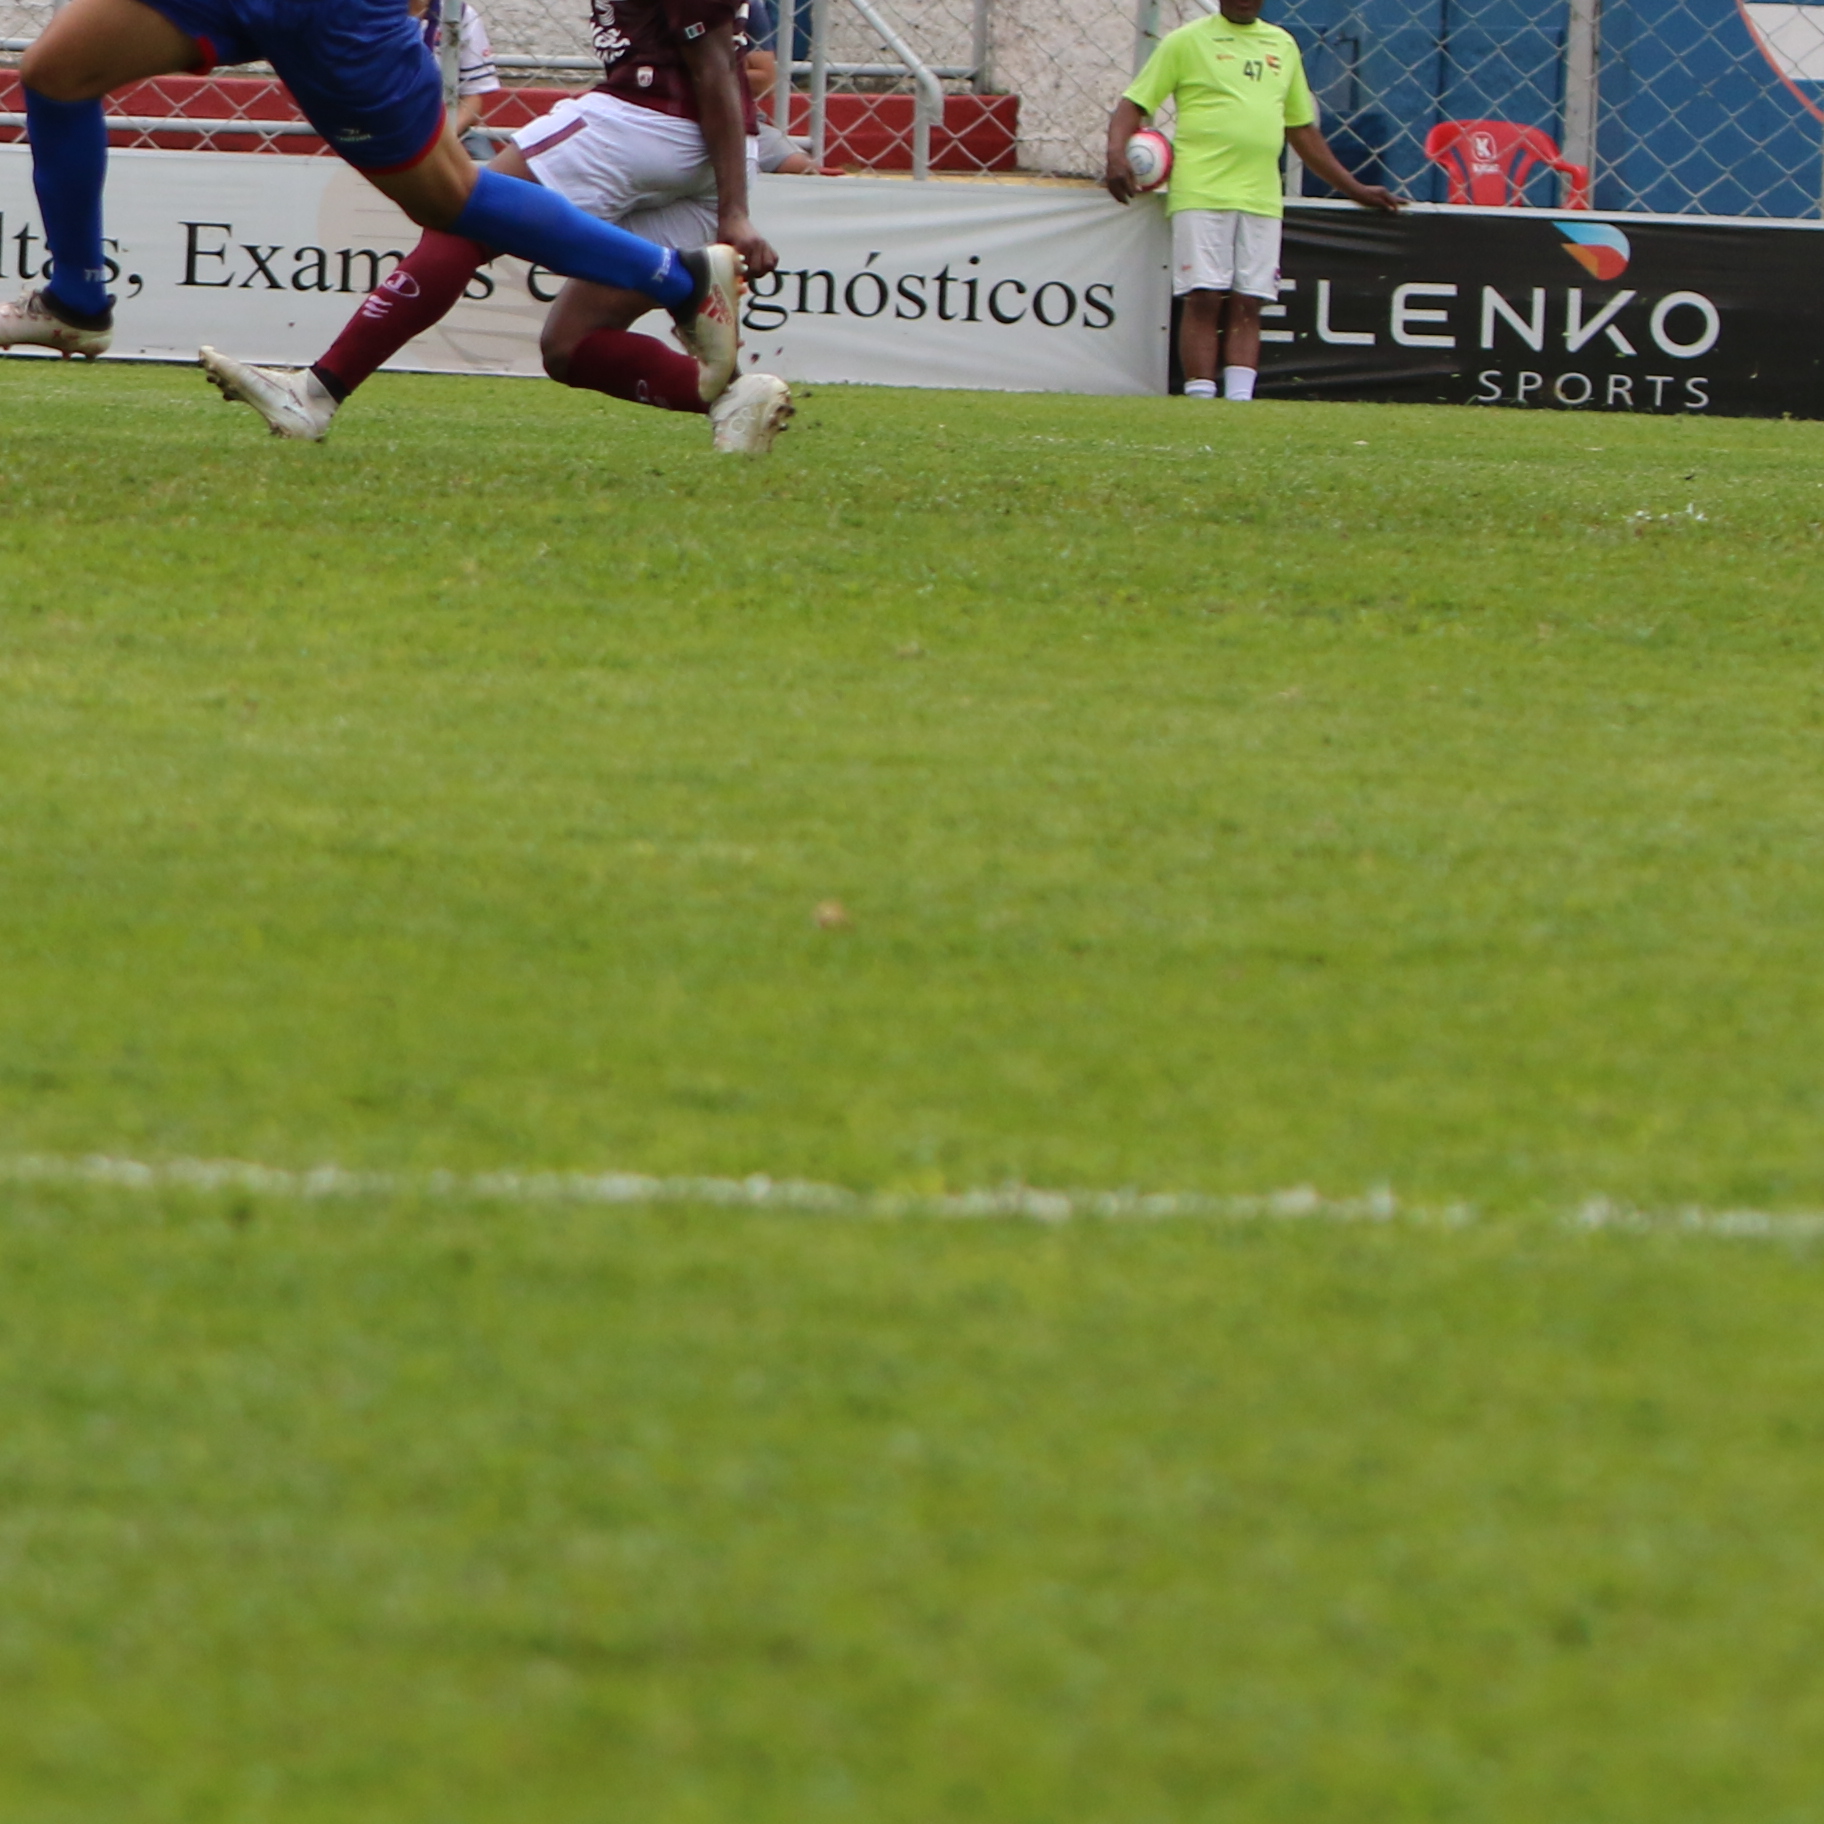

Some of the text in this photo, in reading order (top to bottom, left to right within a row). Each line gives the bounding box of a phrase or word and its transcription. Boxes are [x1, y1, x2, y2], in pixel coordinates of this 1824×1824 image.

[1244, 60, 1263, 82] 47
[178, 220, 494, 300] Exams
[1476, 368, 1712, 409] SPORTS
